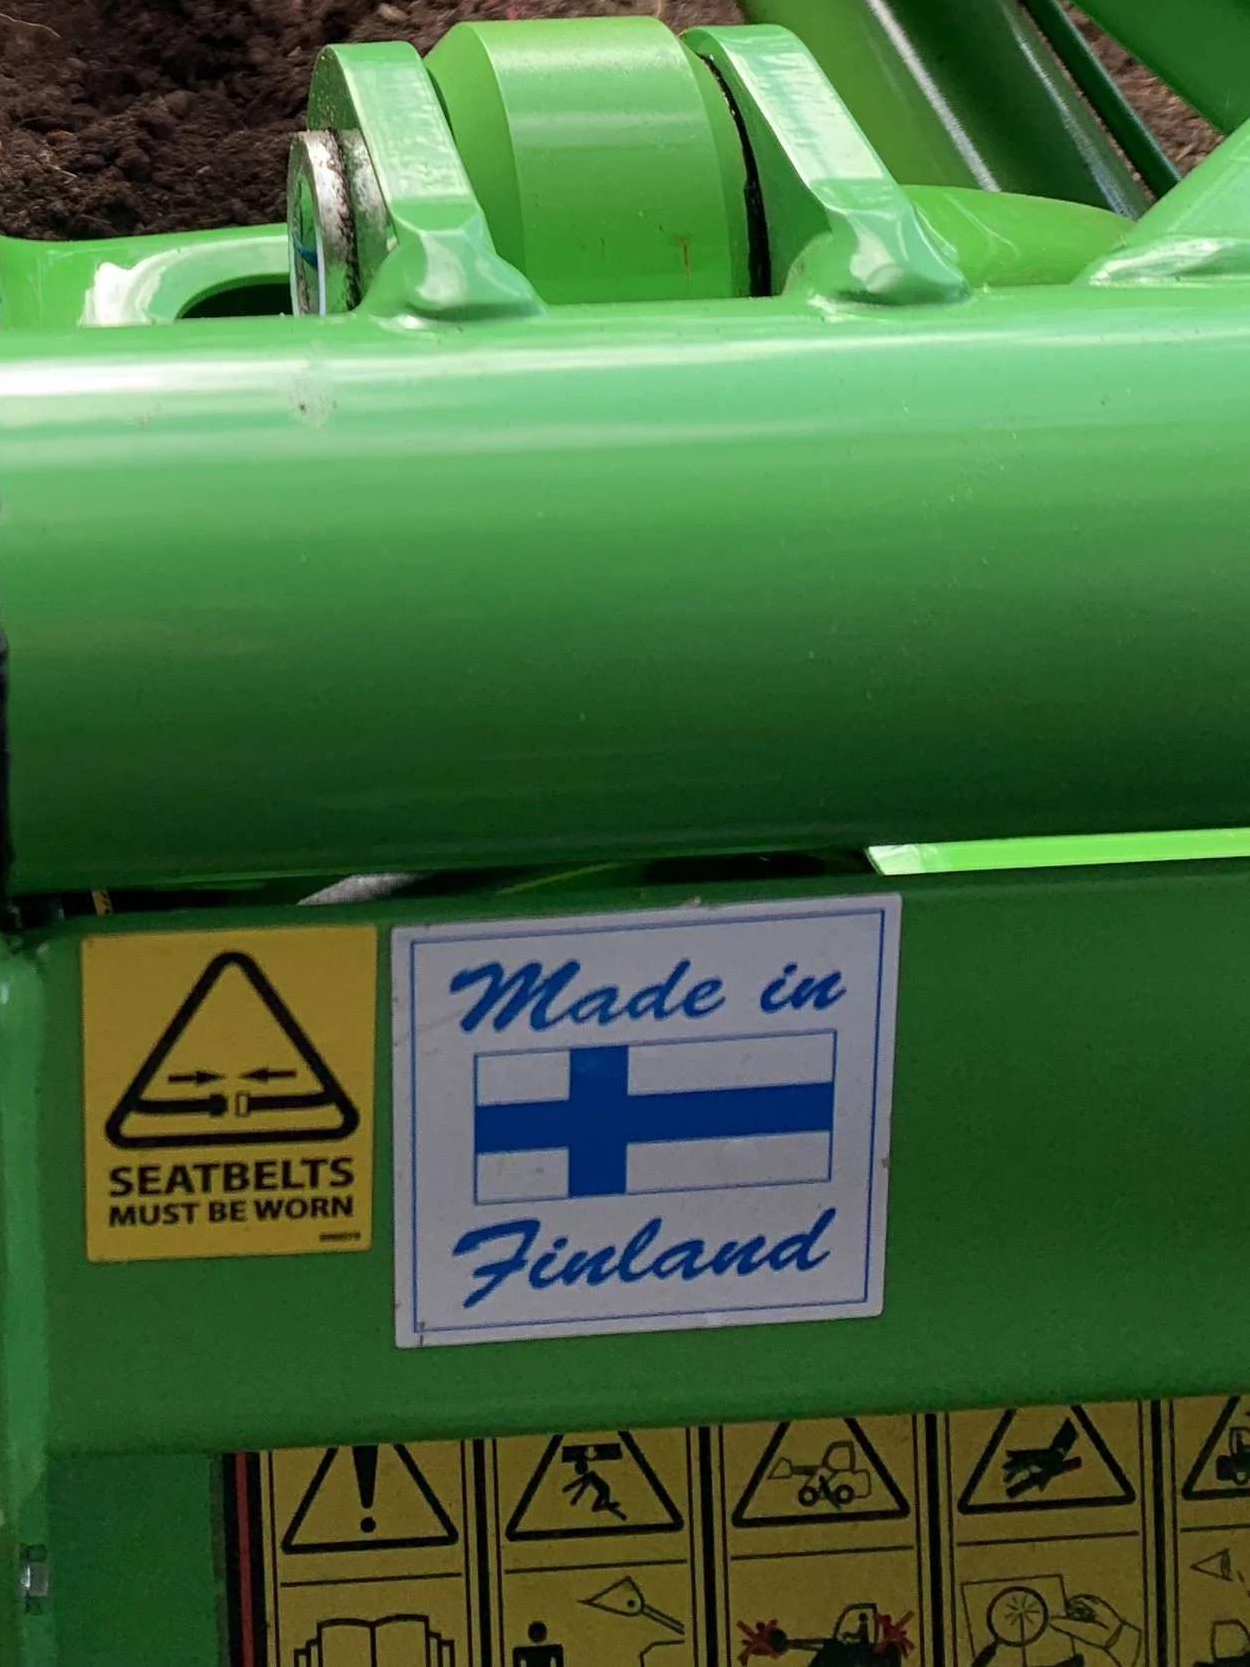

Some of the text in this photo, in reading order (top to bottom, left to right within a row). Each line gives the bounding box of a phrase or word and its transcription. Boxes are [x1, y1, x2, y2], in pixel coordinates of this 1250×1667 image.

[450, 957, 847, 1032] Made in
[109, 1157, 355, 1198] SEATBELTS
[109, 1195, 354, 1228] MUST BE WORN
[452, 1206, 837, 1309] Finland
